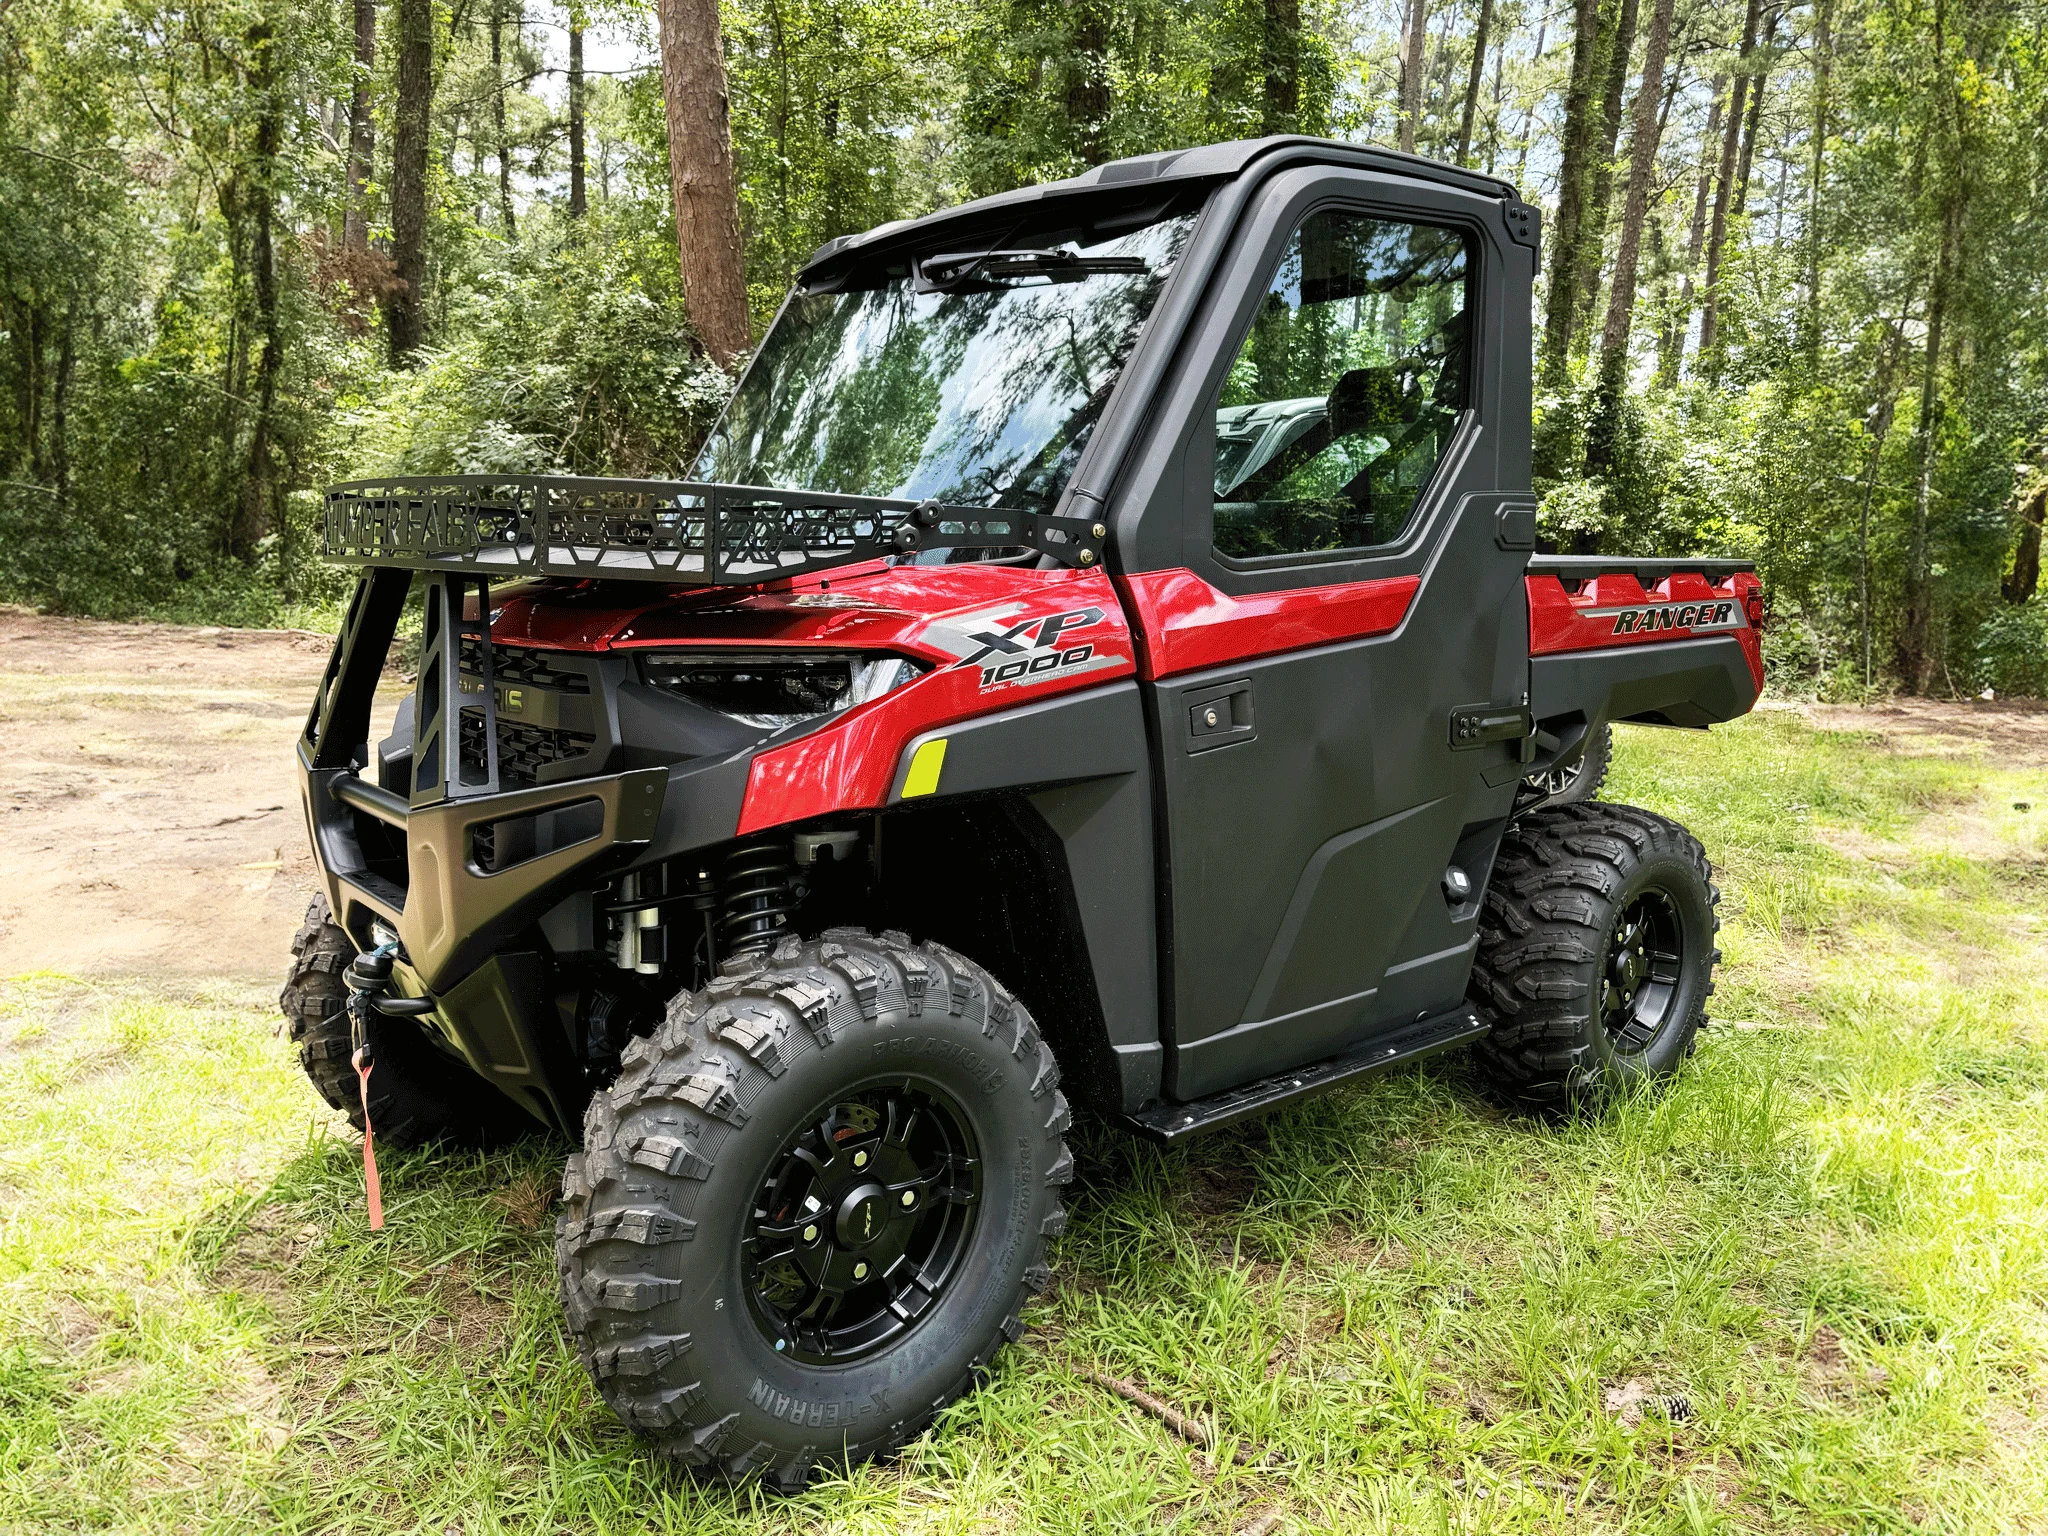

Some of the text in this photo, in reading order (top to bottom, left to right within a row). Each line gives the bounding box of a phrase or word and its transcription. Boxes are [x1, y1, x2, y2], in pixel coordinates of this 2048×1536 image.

[407, 499, 466, 547] FAB
[950, 606, 1106, 670] XP
[1612, 602, 1733, 635] RANGER
[978, 643, 1094, 689] 1000
[979, 663, 1089, 696] DUAL OVERHEAD CAM
[458, 680, 523, 714] OLRIS
[871, 1036, 990, 1081] PRO ARMOR
[746, 1374, 893, 1429] X-TERRAIN
